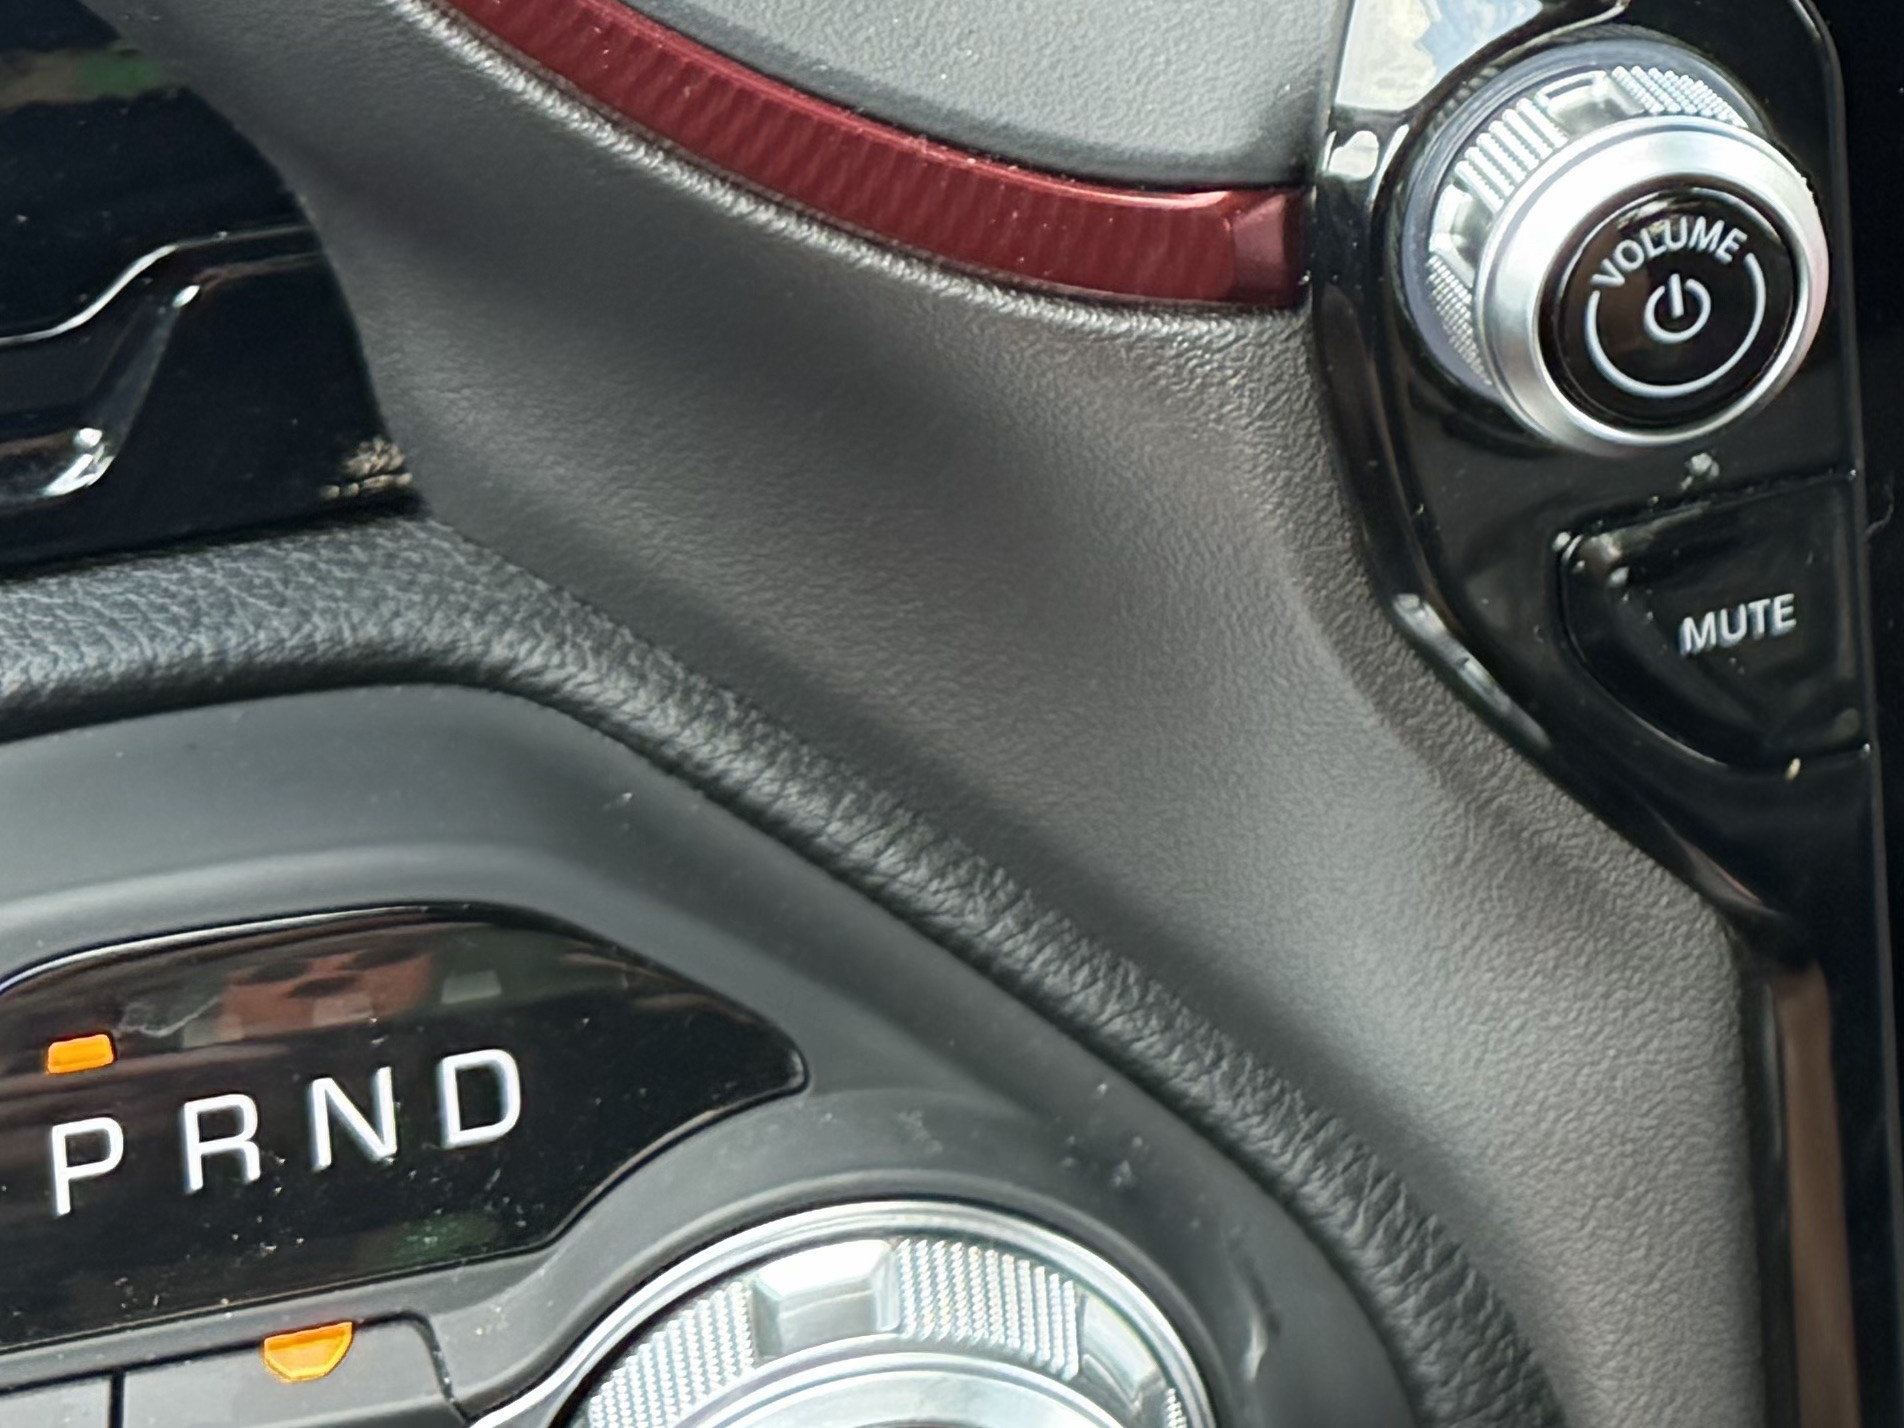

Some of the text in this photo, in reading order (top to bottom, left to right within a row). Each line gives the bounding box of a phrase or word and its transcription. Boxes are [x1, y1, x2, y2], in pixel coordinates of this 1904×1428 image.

[1591, 215, 1748, 289] VOLUME
[1678, 594, 1797, 658] MUTE
[50, 1048, 522, 1216] P R N D
